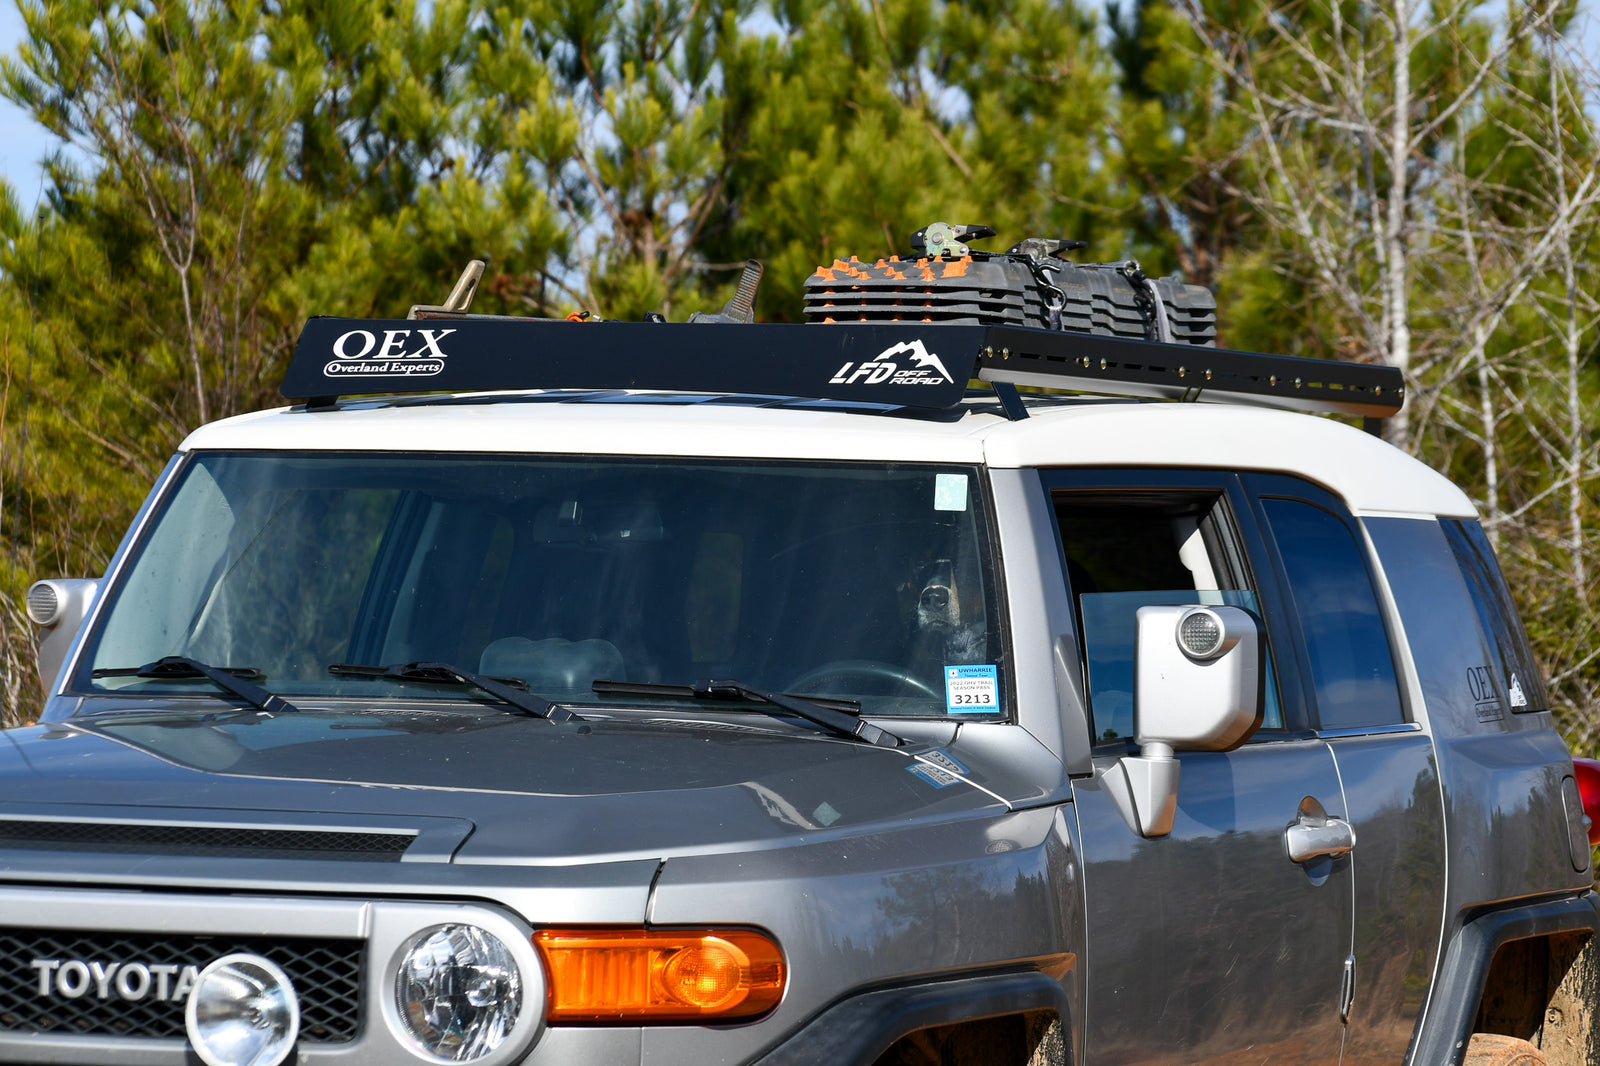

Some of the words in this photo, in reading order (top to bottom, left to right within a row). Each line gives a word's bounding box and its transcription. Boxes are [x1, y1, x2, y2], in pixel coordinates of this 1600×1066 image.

[333, 329, 457, 359] OEX
[328, 362, 389, 373] Overland
[390, 362, 440, 375] Experts
[828, 362, 897, 384] LFD
[888, 377, 944, 385] ROAD
[955, 694, 990, 704] 3213
[30, 959, 200, 1001] TOYOTA
